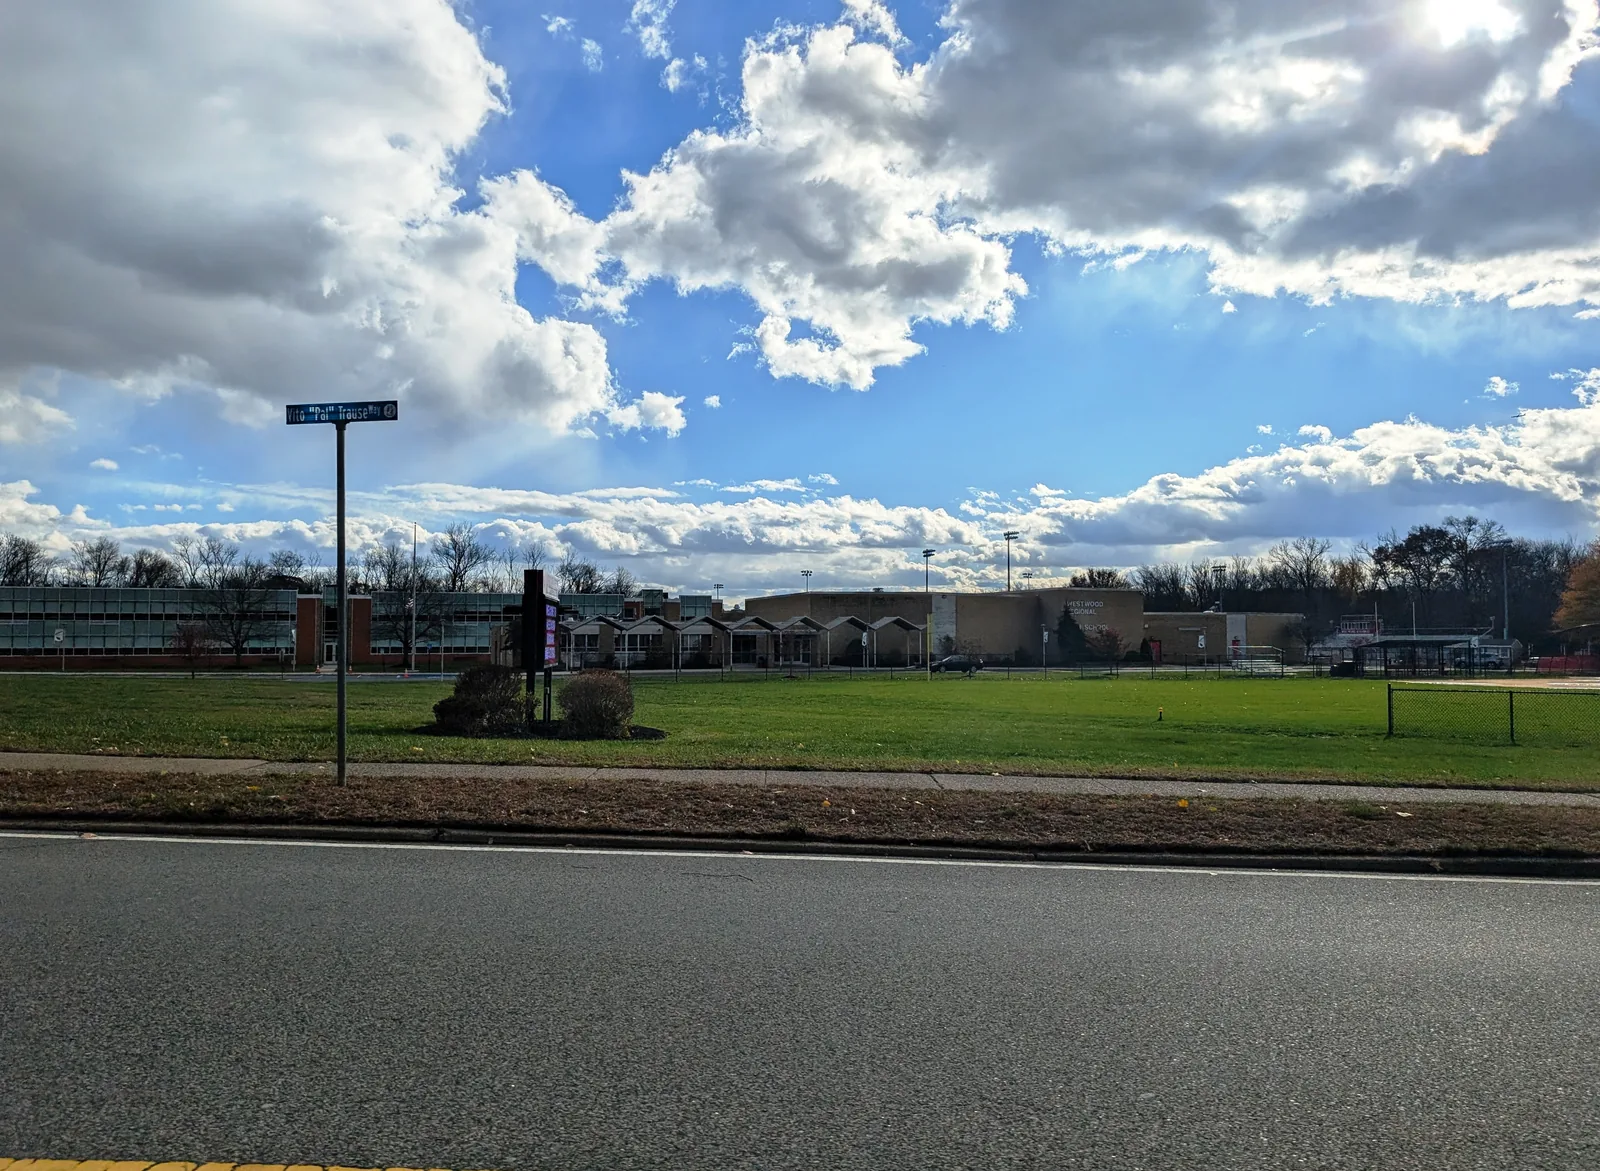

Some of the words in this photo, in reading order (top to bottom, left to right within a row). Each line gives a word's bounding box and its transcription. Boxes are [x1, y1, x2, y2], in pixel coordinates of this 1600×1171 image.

[287, 407, 305, 422] Vito
[309, 406, 334, 421] "Pal"
[338, 405, 368, 420] Trause
[368, 404, 381, 416] Way
